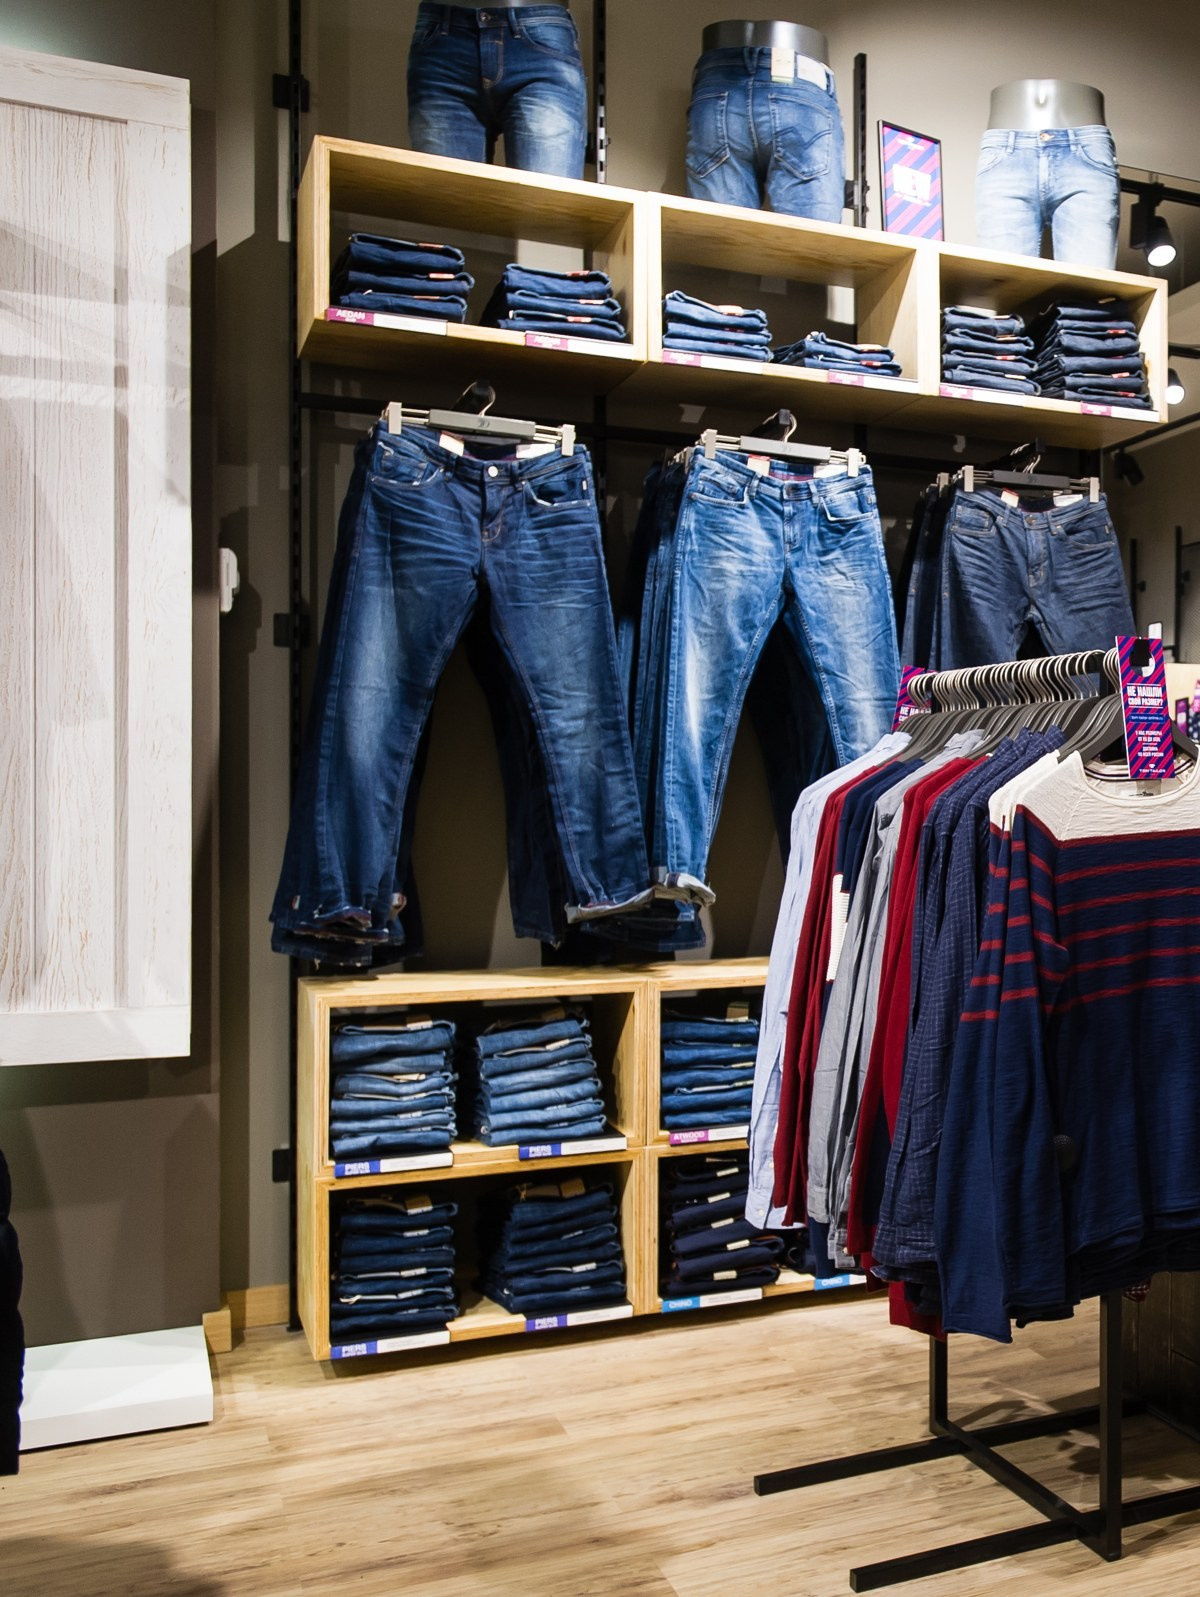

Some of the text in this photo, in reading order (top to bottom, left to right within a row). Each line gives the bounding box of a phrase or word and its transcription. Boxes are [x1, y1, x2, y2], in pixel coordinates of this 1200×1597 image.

[1127, 686, 1162, 698] НЕ НАШЛИ
[673, 1130, 705, 1140] ATWOOD
[529, 1145, 552, 1155] PIERS
[345, 1162, 370, 1171] PIERS
[669, 1299, 692, 1309] CHINO
[342, 1343, 367, 1353] PIERS
